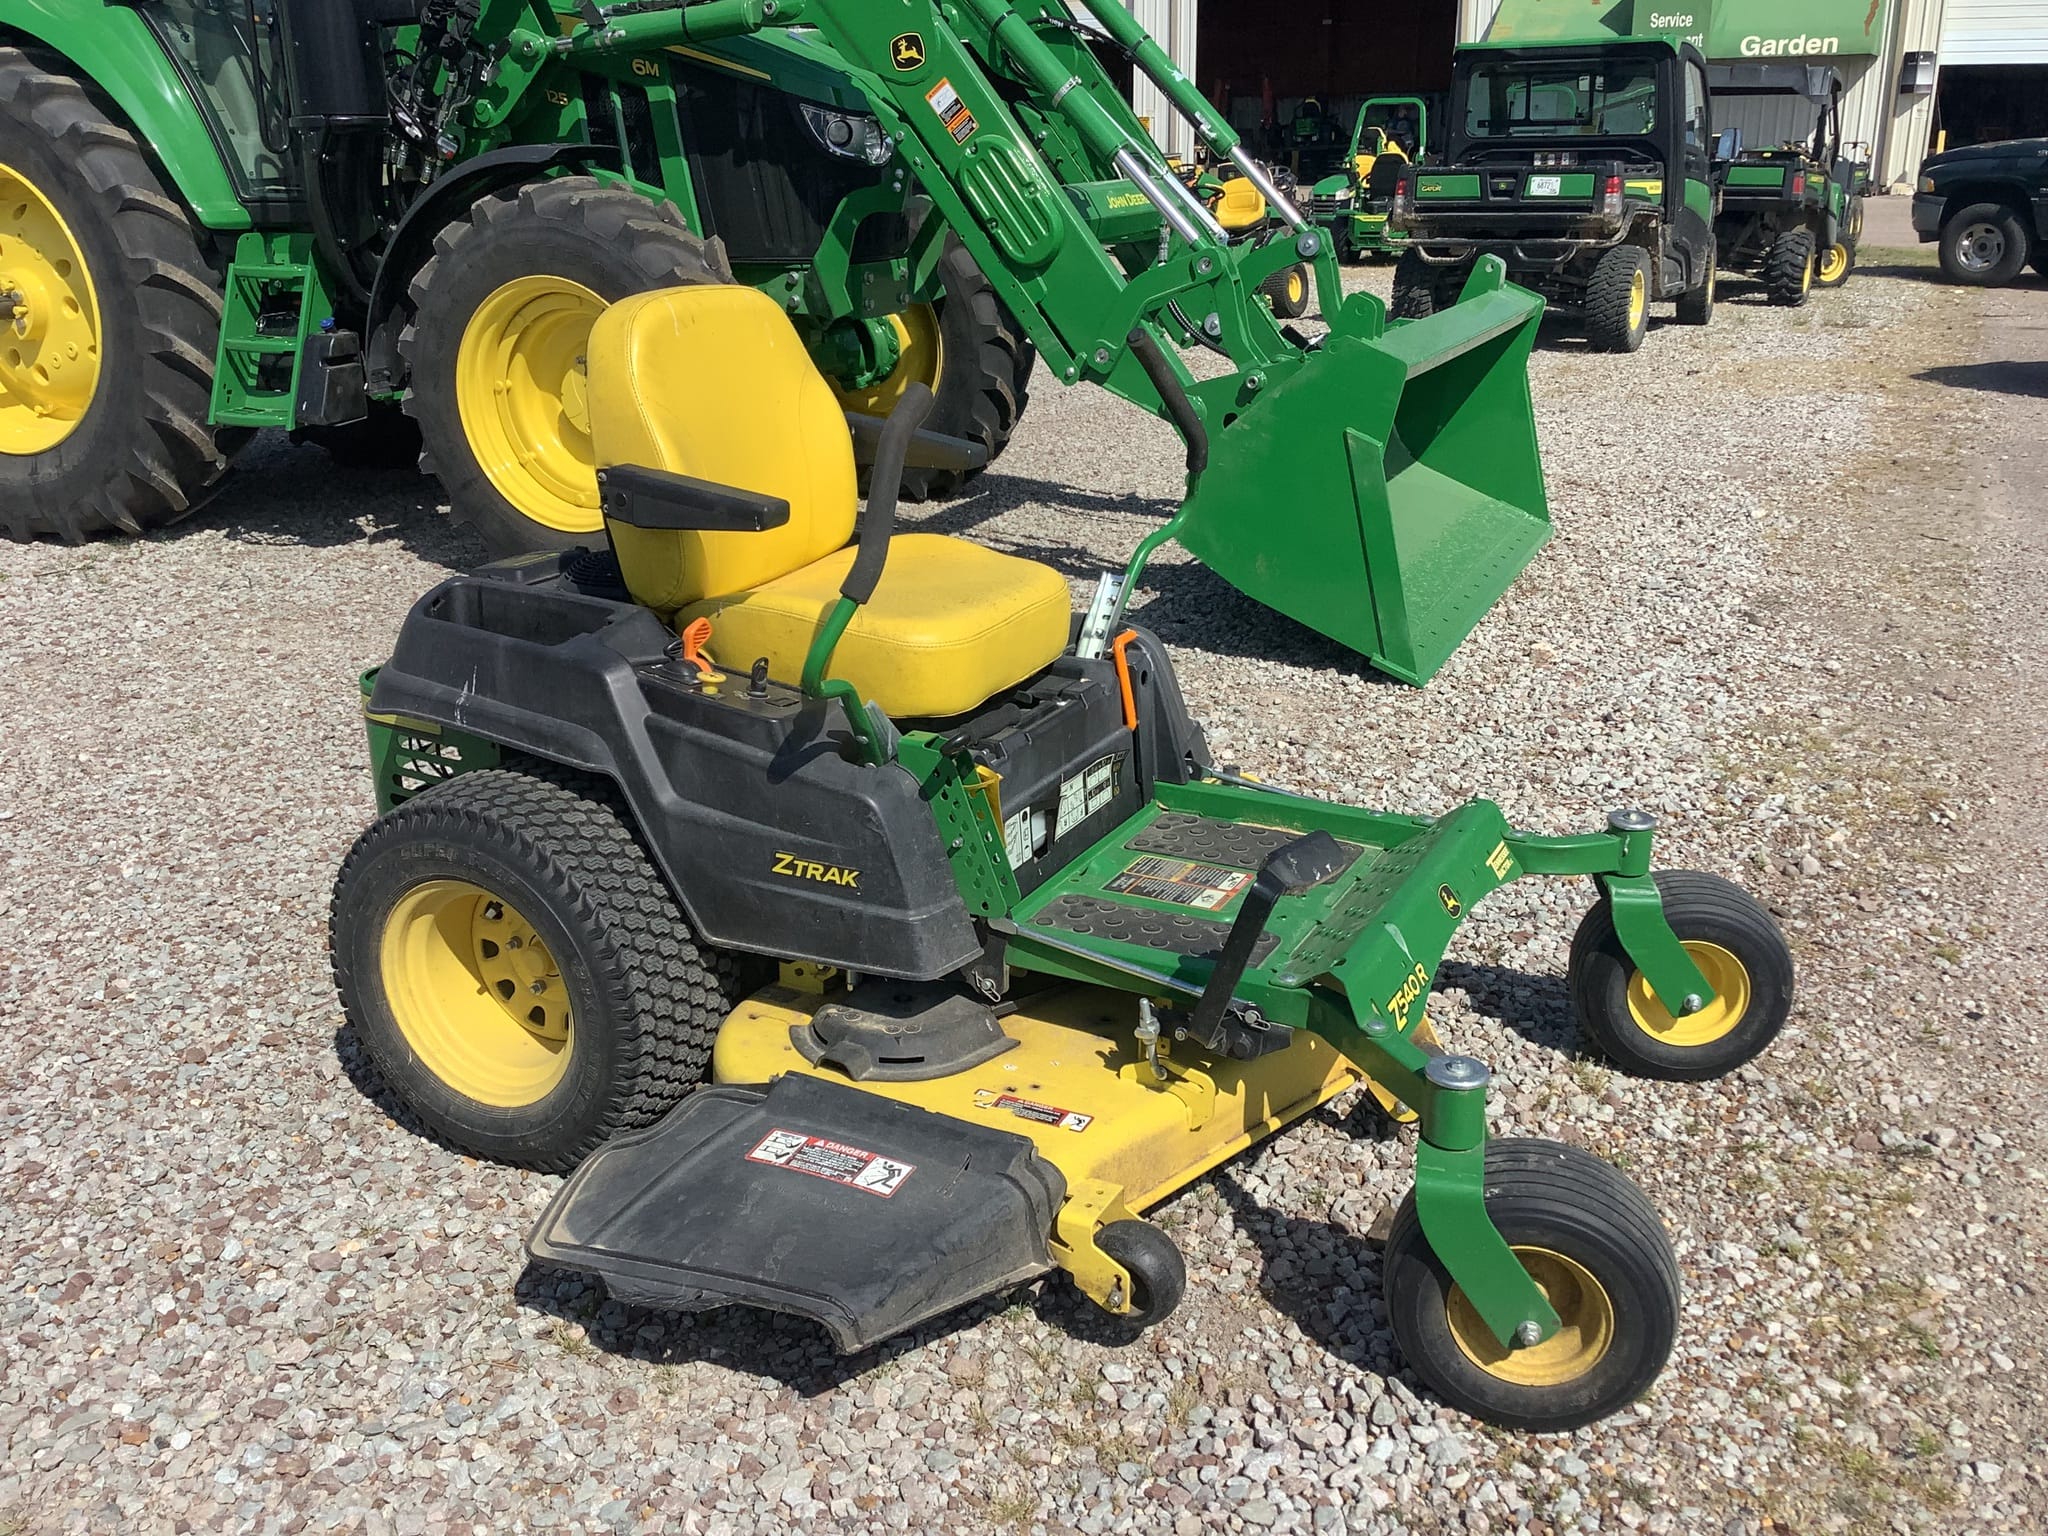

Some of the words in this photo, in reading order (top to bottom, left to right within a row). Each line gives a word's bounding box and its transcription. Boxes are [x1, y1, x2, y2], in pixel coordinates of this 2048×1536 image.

[1650, 12, 1693, 28] Service
[1740, 33, 1838, 56] Garden
[632, 59, 660, 77] 6M
[545, 89, 569, 105] 125
[1107, 195, 1126, 209] JOHN
[772, 852, 860, 888] ZTRAK
[825, 1142, 869, 1159] DANGER
